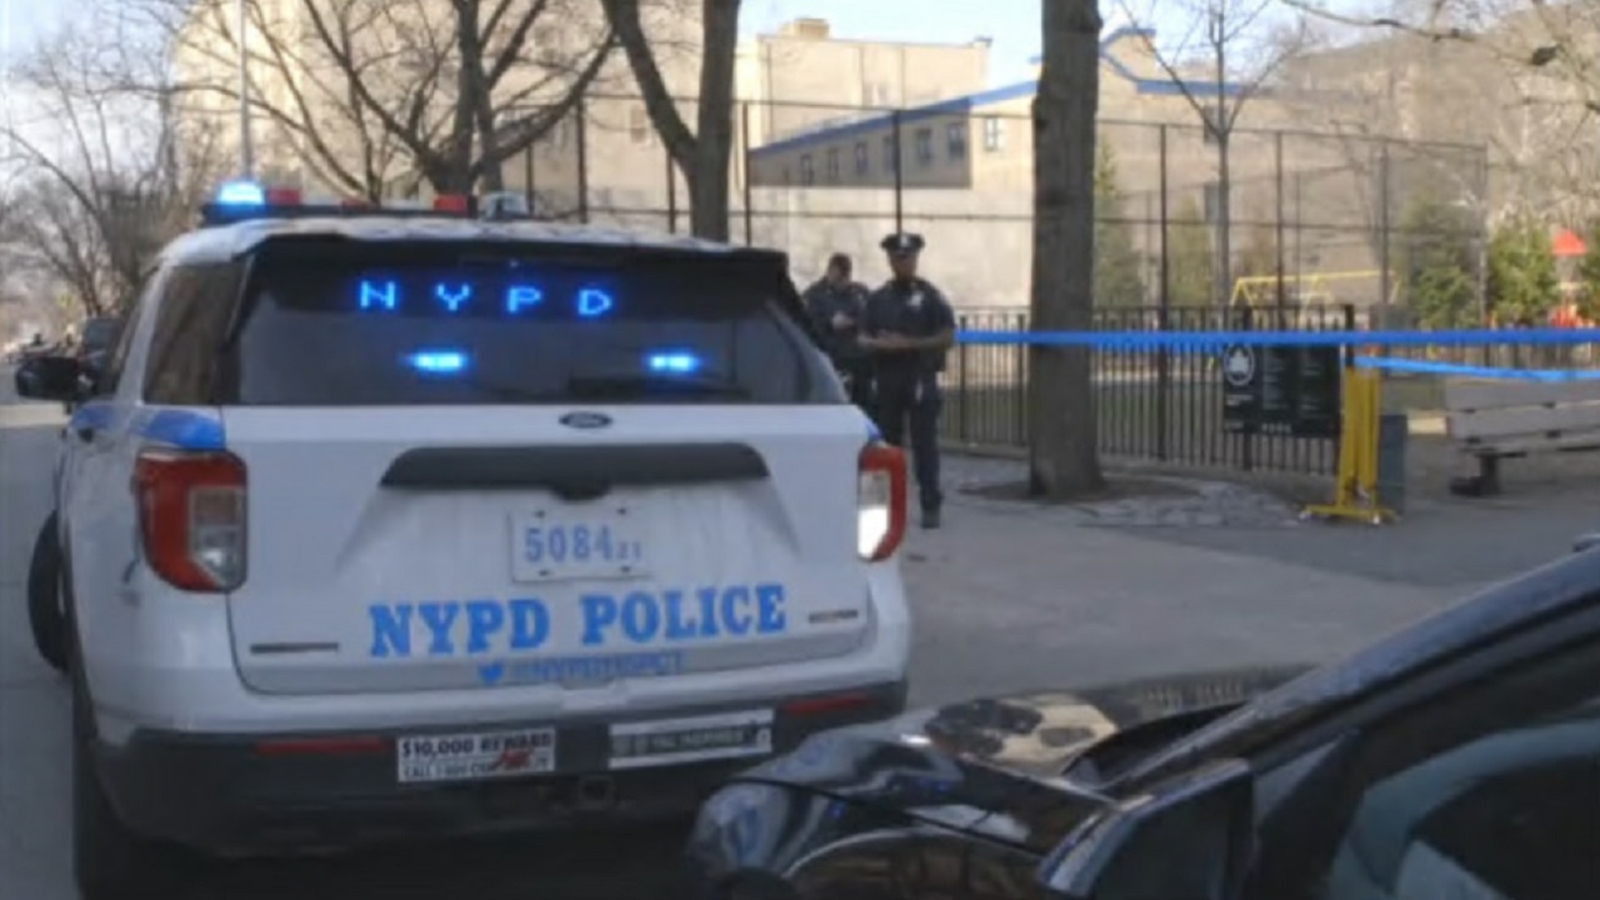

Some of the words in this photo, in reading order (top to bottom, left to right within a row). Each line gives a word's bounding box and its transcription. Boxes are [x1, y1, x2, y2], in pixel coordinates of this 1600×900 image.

[359, 280, 612, 316] NYPD
[525, 526, 613, 562] 5084
[369, 598, 550, 658] NYPD
[579, 583, 787, 646] POLICE
[402, 737, 475, 759] $10,000
